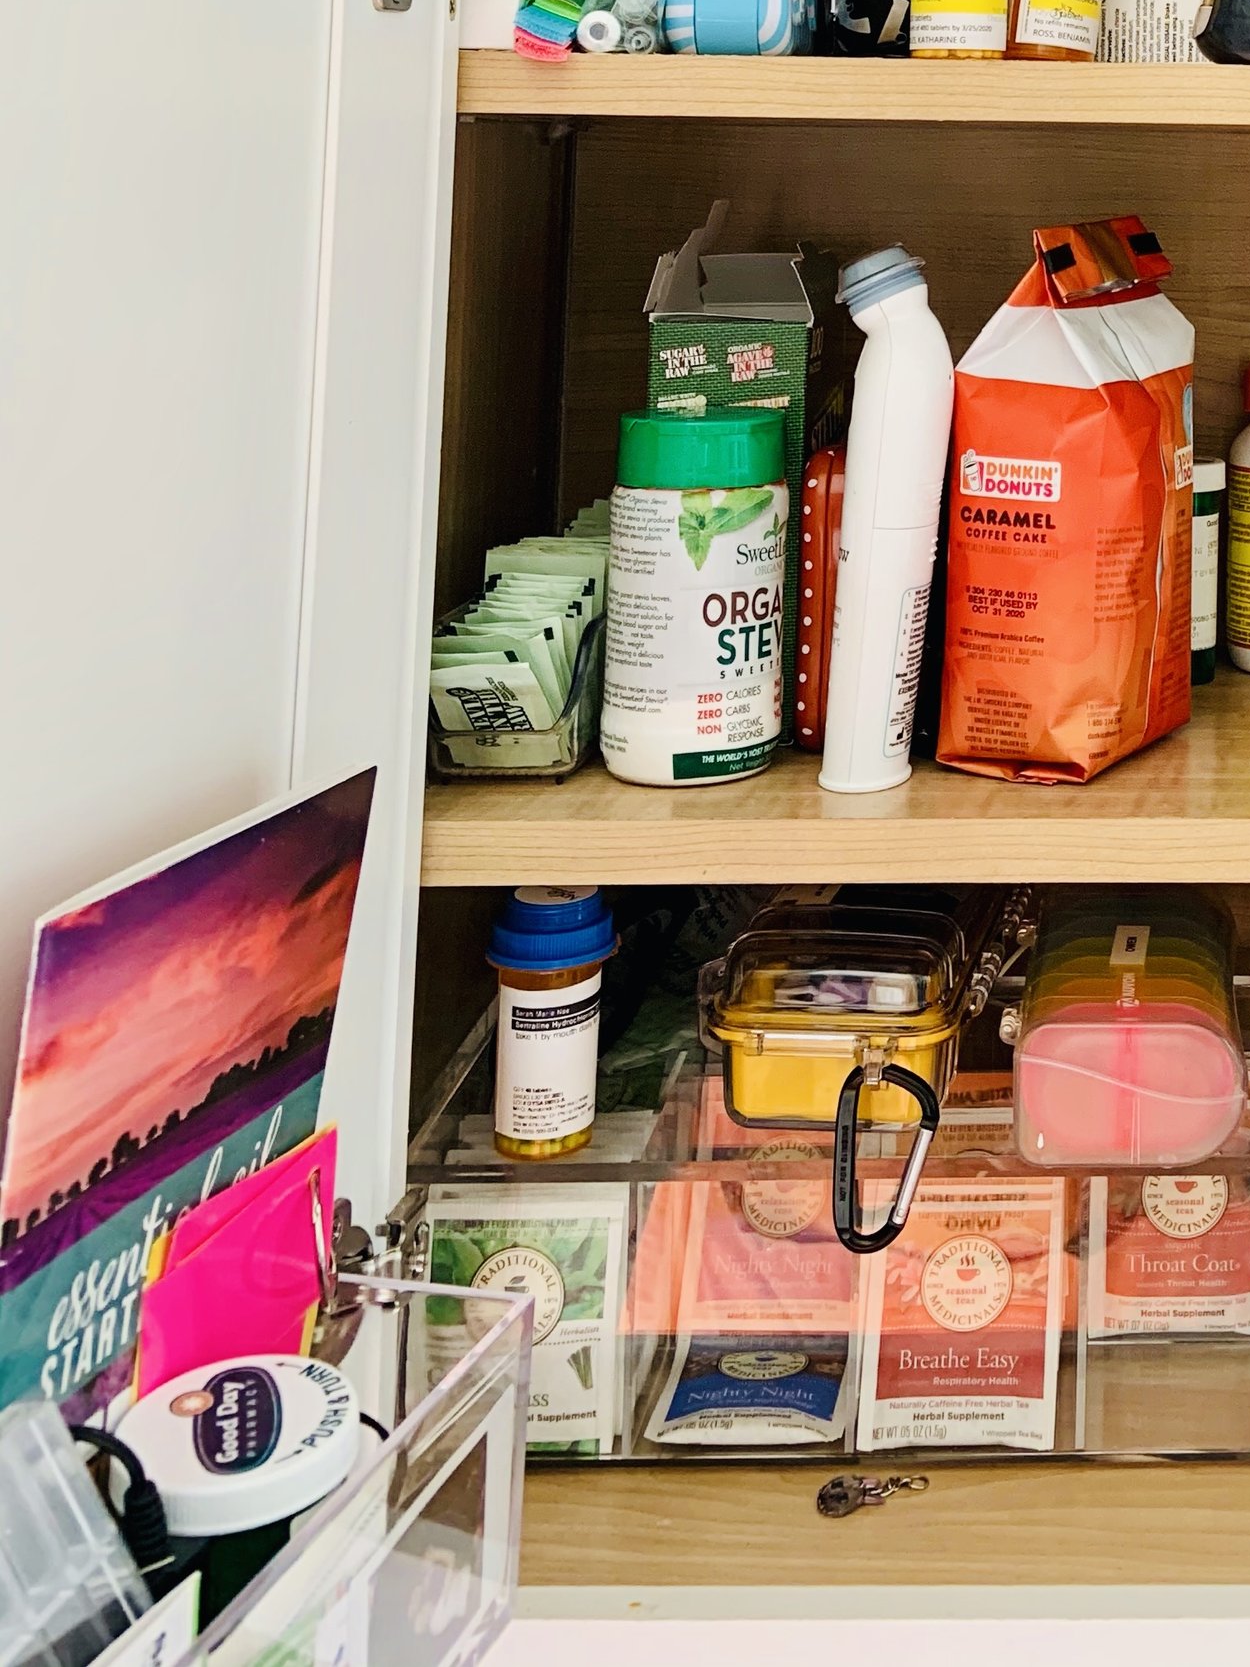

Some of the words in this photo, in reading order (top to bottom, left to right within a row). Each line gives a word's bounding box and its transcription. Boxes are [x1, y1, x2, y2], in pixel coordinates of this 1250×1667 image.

[985, 478, 1053, 497] DONUTS
[960, 506, 1056, 529] CARAMEL
[966, 527, 1007, 541] COFFEE
[1013, 532, 1047, 543] CAKE
[972, 604, 989, 614] OCT
[993, 606, 1001, 616] 31
[1006, 608, 1025, 618] 2020
[697, 693, 723, 703] ZERO
[726, 685, 761, 701] CALORIES
[728, 727, 764, 743] RESPONSE
[840, 1165, 848, 1183] FOR
[1151, 1203, 1219, 1233] MEDICINALS
[928, 1241, 1006, 1277] TRADITIONAL
[1126, 1254, 1187, 1273] Throat
[1192, 1254, 1236, 1272] Coat
[945, 1287, 987, 1295] seasonal
[929, 1292, 1003, 1326] MEDICINALS
[899, 1347, 970, 1370] Breathe
[977, 1347, 1020, 1374] Easy
[303, 1364, 346, 1395] TURN
[217, 1381, 245, 1416] Day
[688, 1388, 752, 1405] Nighty
[761, 1387, 815, 1402] Night
[537, 1410, 596, 1422] Supplement
[913, 1412, 945, 1421] Herbal
[948, 1412, 1005, 1422] Supplement
[305, 1409, 343, 1448] PUSH
[215, 1419, 240, 1463] Good
